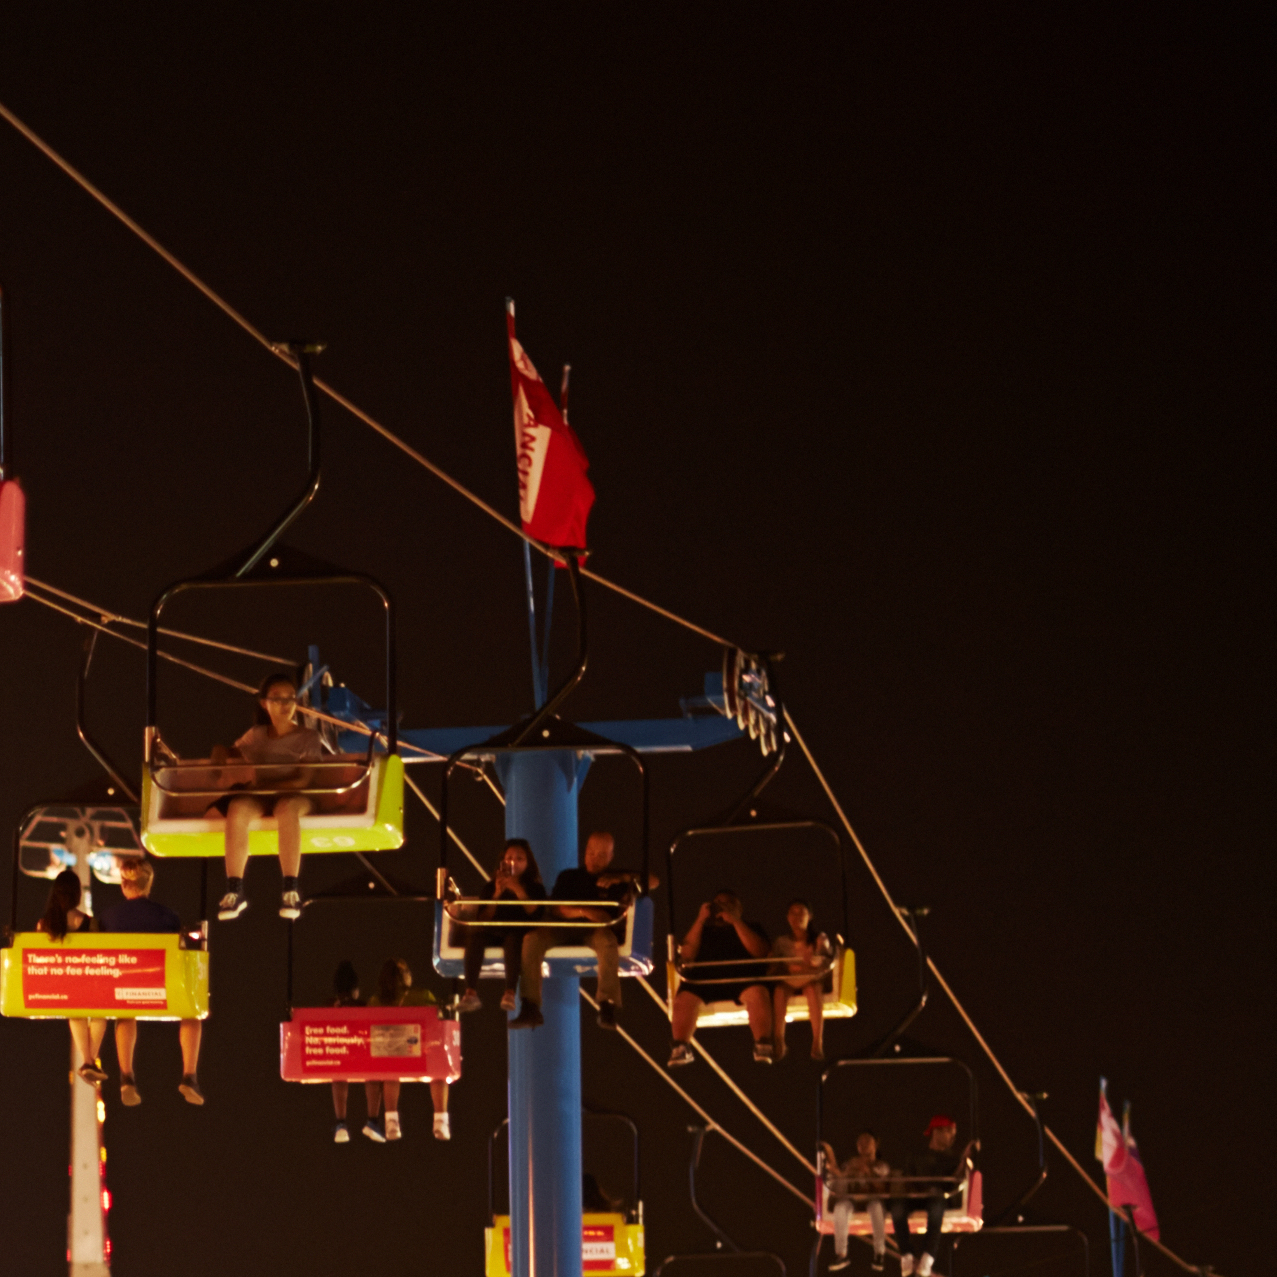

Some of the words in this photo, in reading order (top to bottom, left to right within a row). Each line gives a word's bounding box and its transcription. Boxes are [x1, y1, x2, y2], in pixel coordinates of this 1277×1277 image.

[517, 409, 540, 502] ANCIA
[65, 956, 80, 964] no
[81, 954, 116, 966] feeling
[118, 954, 138, 964] like
[27, 965, 48, 976] that
[50, 967, 64, 976] no
[66, 966, 82, 976] fee
[84, 966, 123, 978] feeling.
